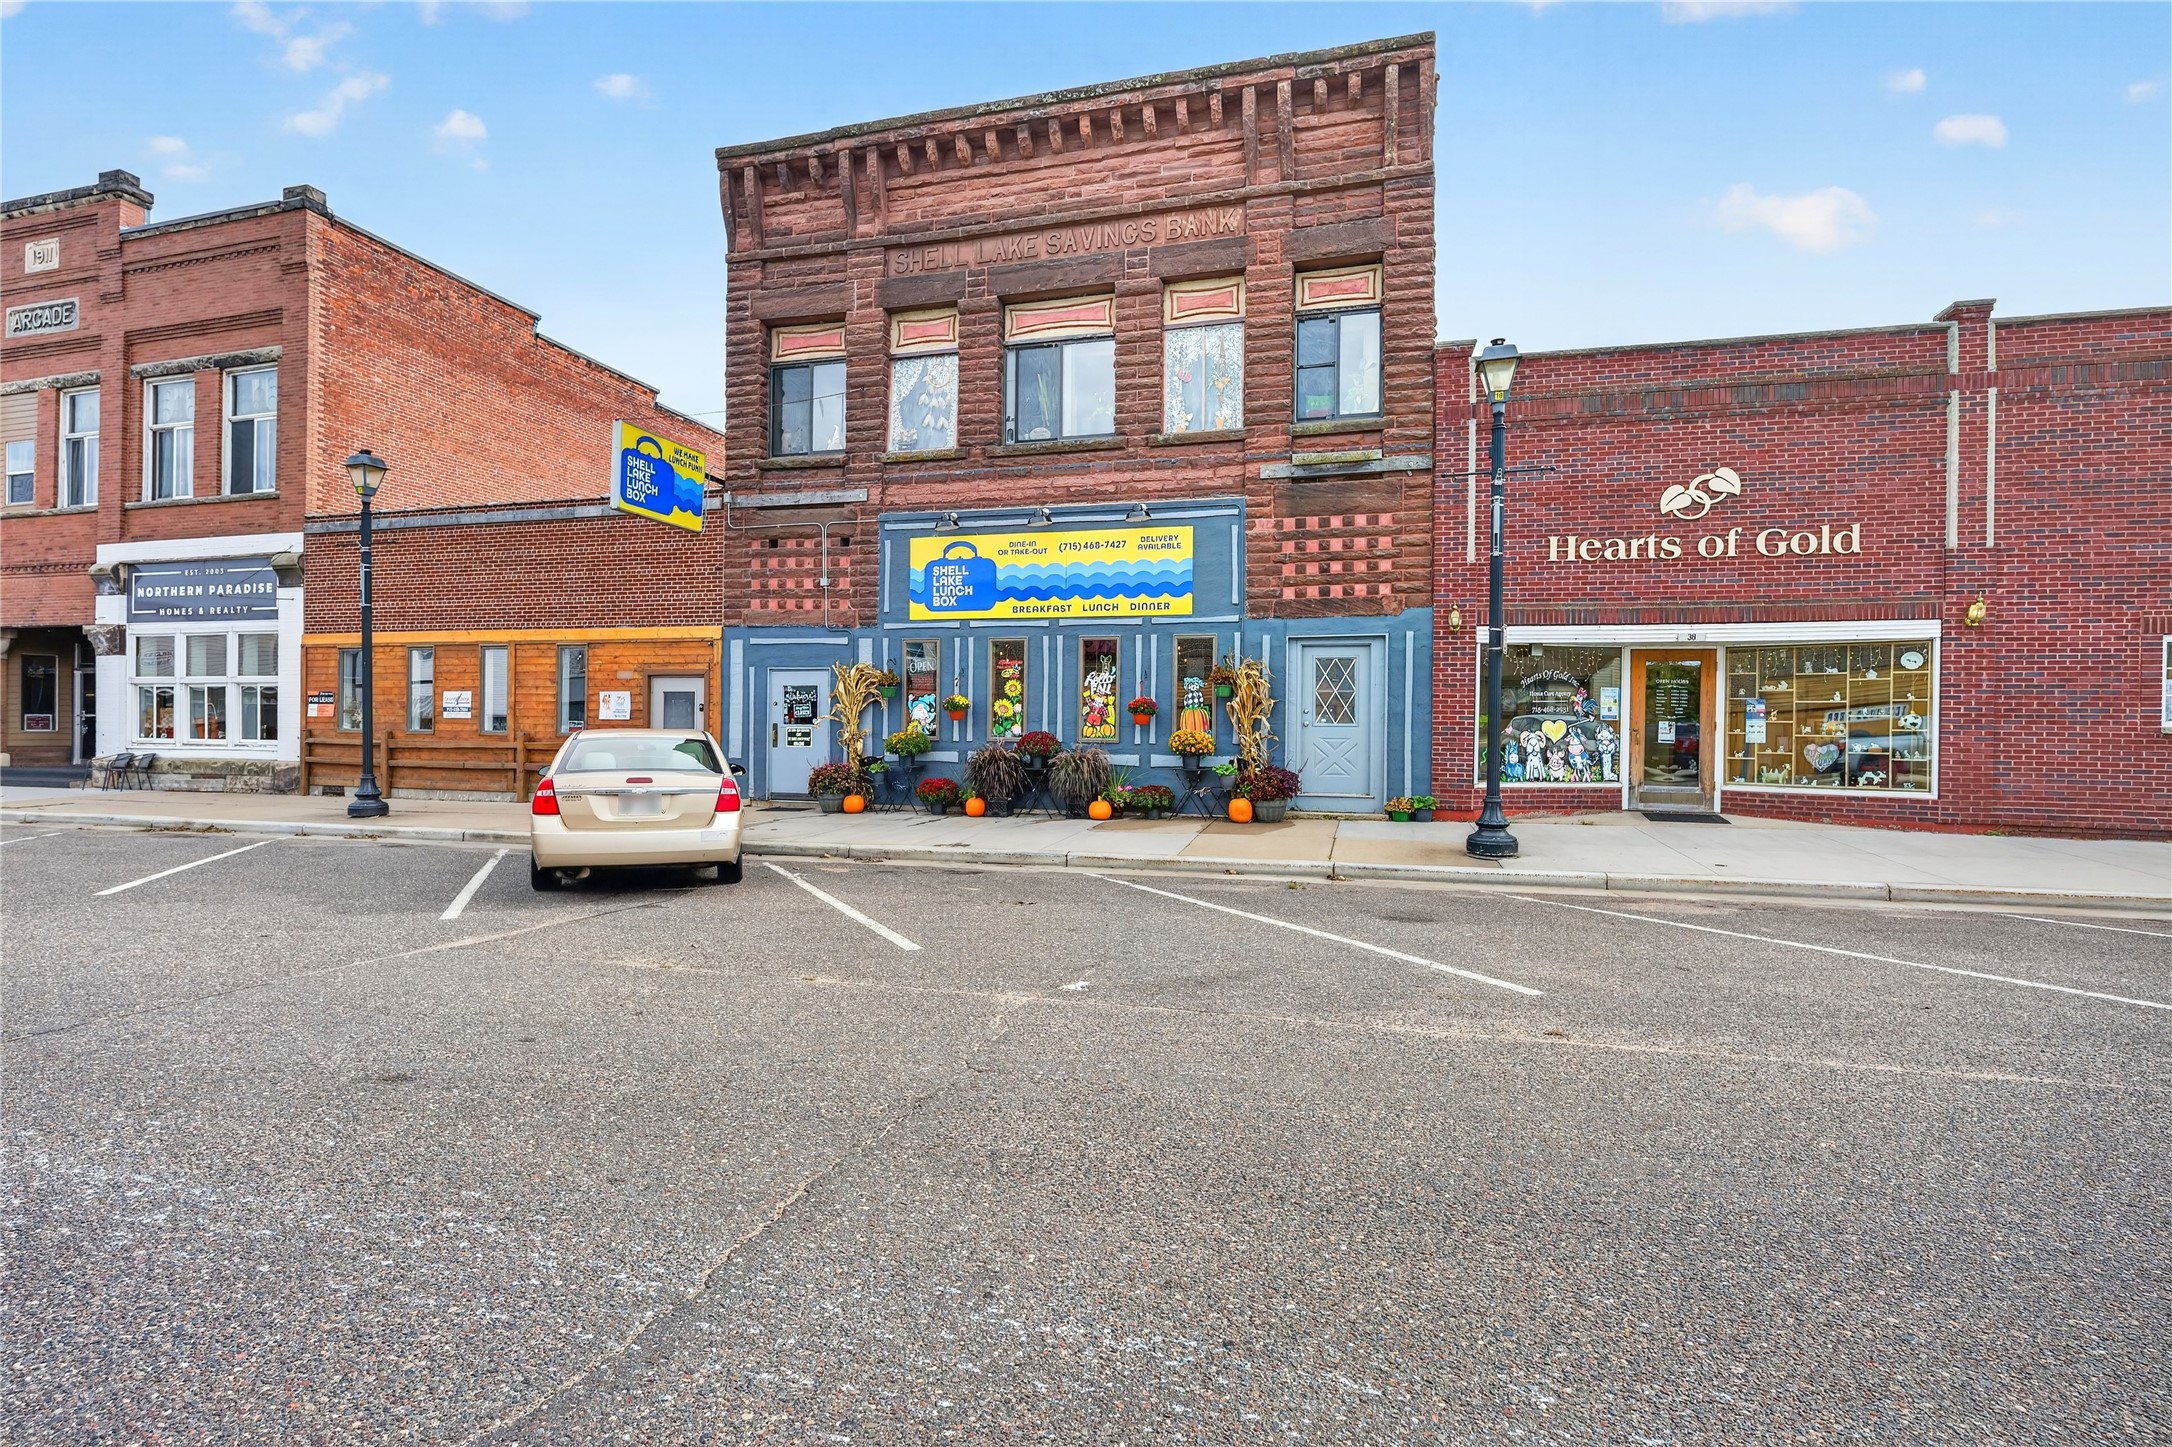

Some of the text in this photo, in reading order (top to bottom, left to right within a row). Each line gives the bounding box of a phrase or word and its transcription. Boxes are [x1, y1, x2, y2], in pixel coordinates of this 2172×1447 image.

[893, 207, 1243, 275] SHELL LAKE SAVINGS BANK
[32, 247, 53, 265] 1911
[12, 304, 74, 333] ARCADE
[668, 455, 688, 468] LUNCH
[674, 447, 698, 463] WE MAKE
[627, 455, 656, 475] SHELL
[627, 466, 651, 483] LAKE
[627, 477, 658, 497] LUNCH
[626, 488, 646, 504] BOX
[997, 542, 1182, 556] OR TAKE-OUT AVAILABLE
[1058, 541, 1082, 552] (715)
[1082, 540, 1127, 551] 468-7427
[1140, 534, 1179, 543] DELIVERY
[1547, 523, 1861, 562] Hearts of Gold
[932, 565, 969, 576] SHELL
[933, 575, 963, 586] LAKE
[137, 583, 273, 598] NORTHERN PARADISE
[933, 585, 973, 596] LUNCH
[932, 596, 958, 607] BOX
[1012, 602, 1170, 614] BREAKFAST LUNCH DINNER
[159, 605, 249, 616] HOMES & REALTY
[1687, 633, 1697, 641] 38
[909, 661, 935, 673] OPEN
[1520, 672, 1543, 689] Hearts
[1553, 670, 1569, 681] Gold
[1091, 683, 1112, 696] FALL
